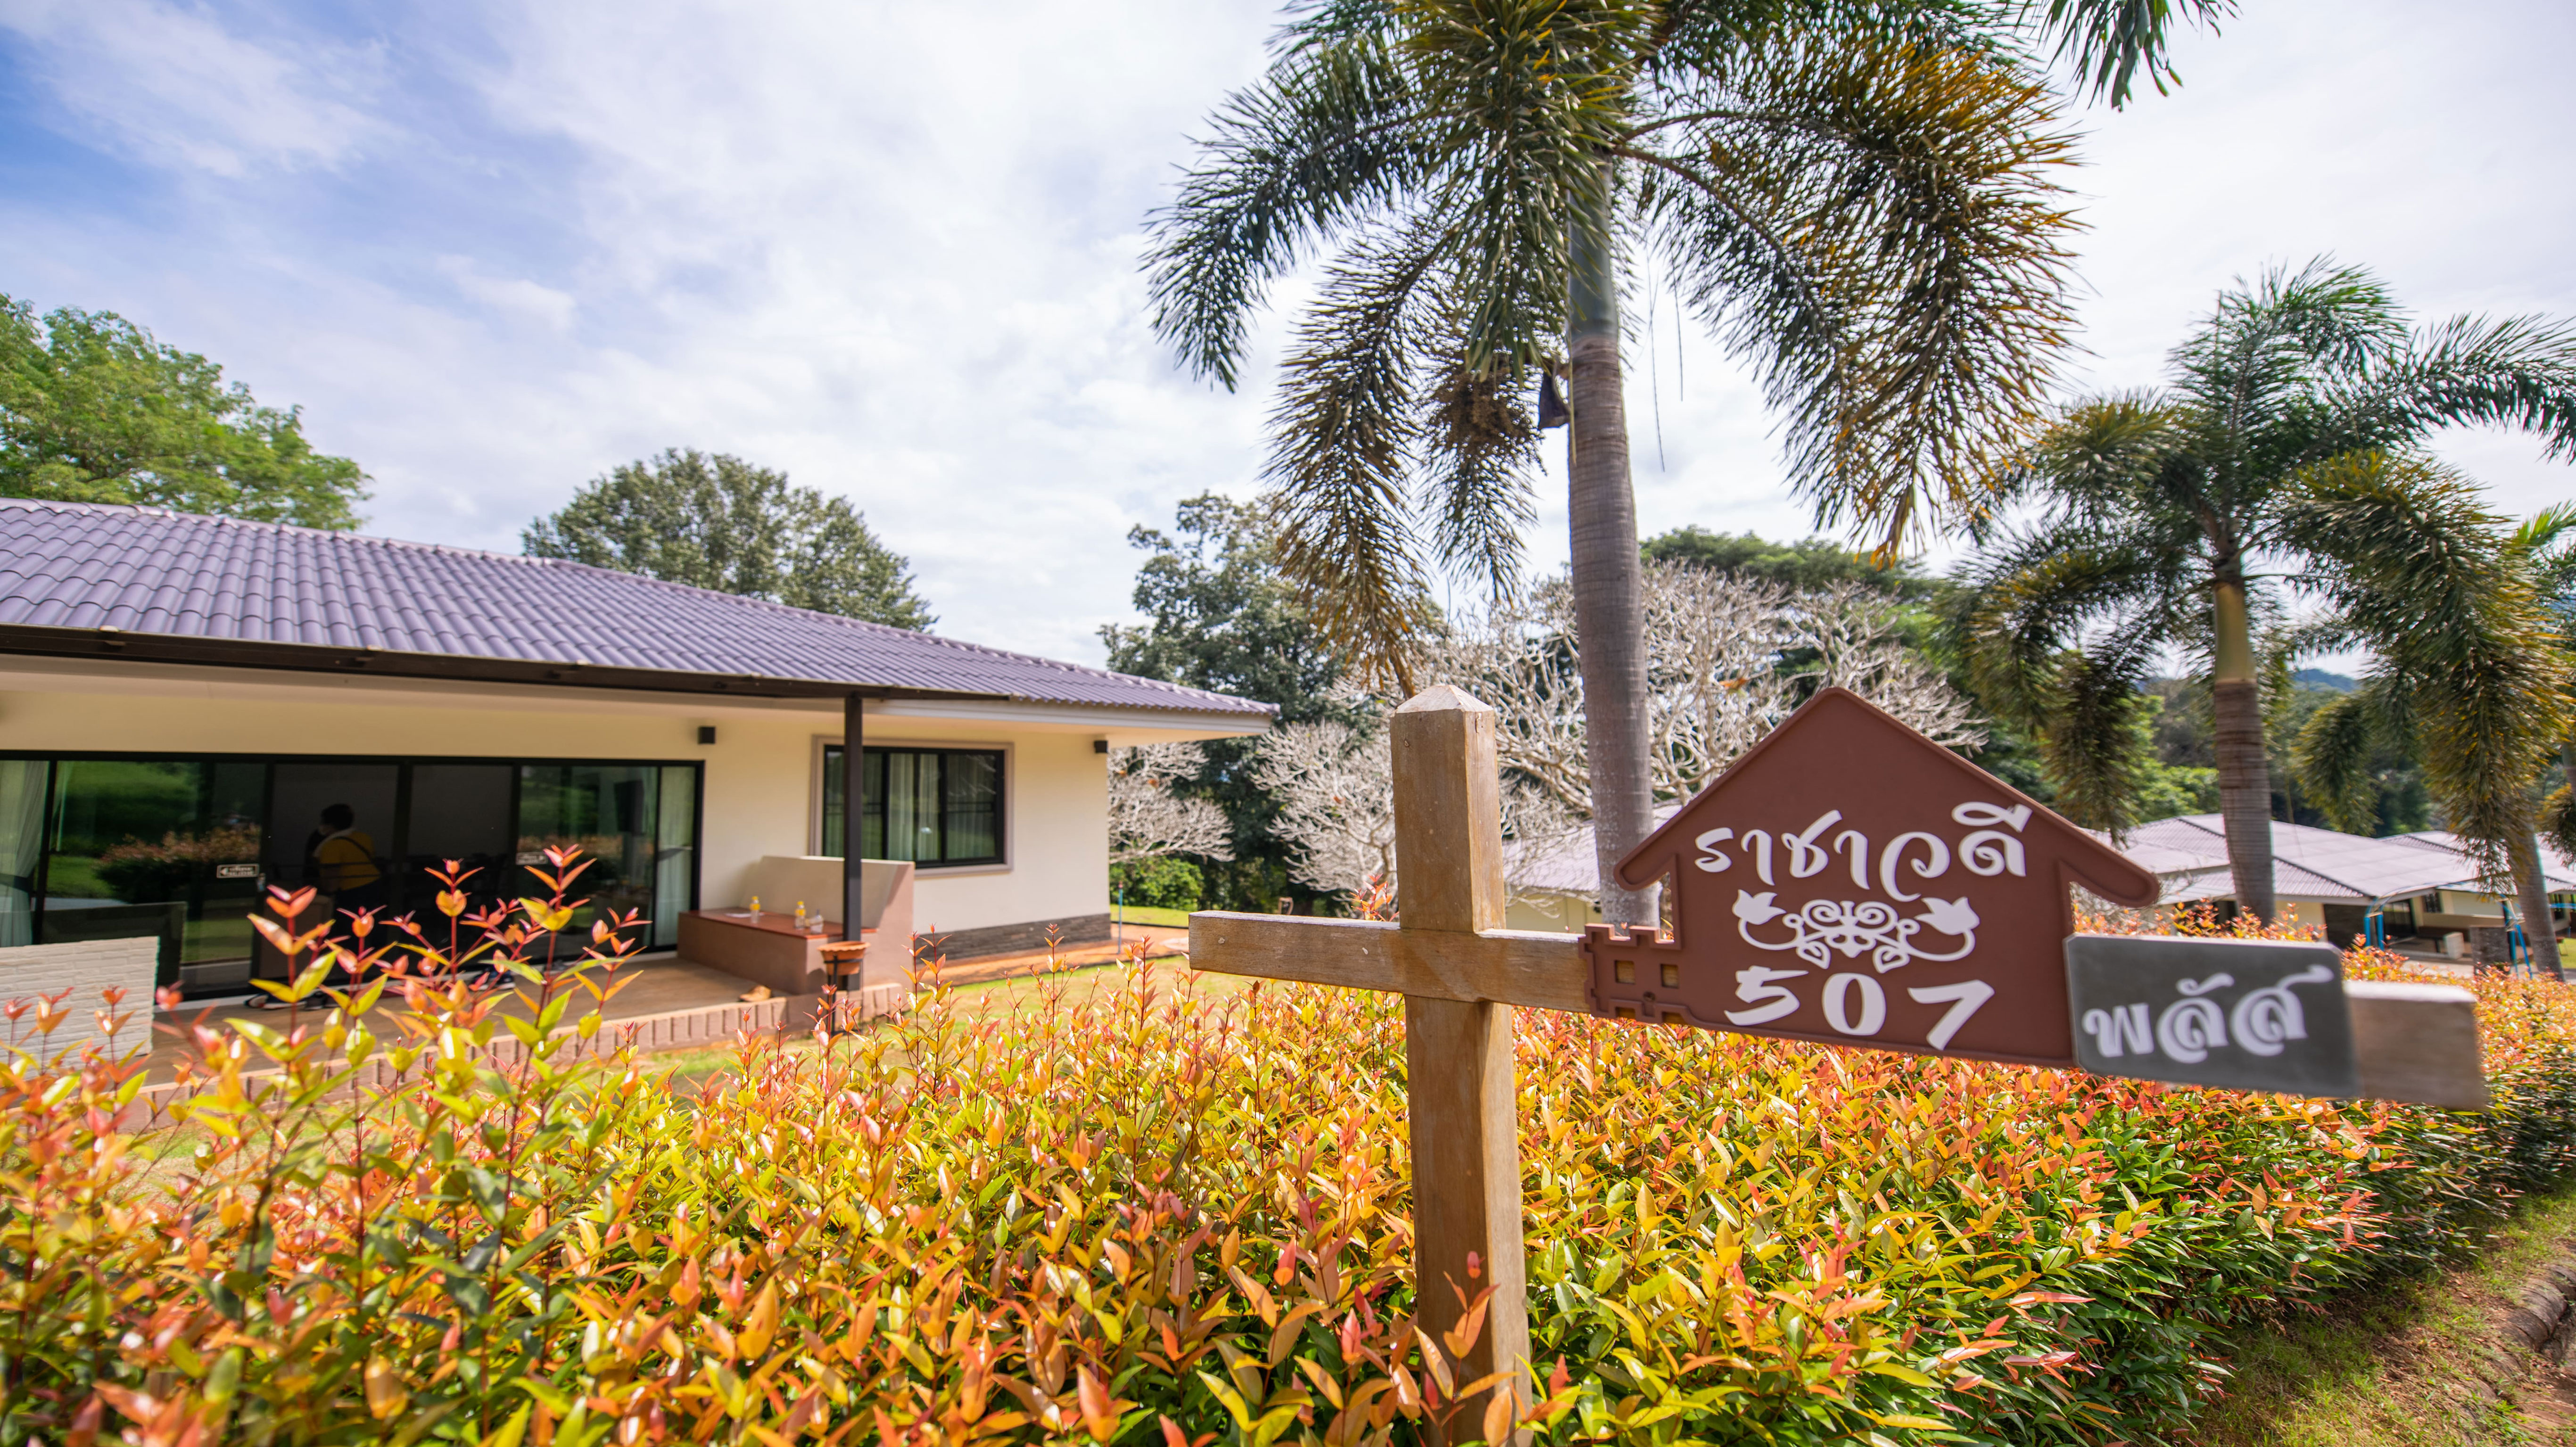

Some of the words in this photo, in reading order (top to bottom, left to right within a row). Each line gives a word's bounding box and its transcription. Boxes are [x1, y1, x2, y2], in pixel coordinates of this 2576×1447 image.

[1695, 802, 2032, 902] ราชาวดี
[1724, 965, 1995, 1050] 507
[2083, 965, 2334, 1064] พลัส
